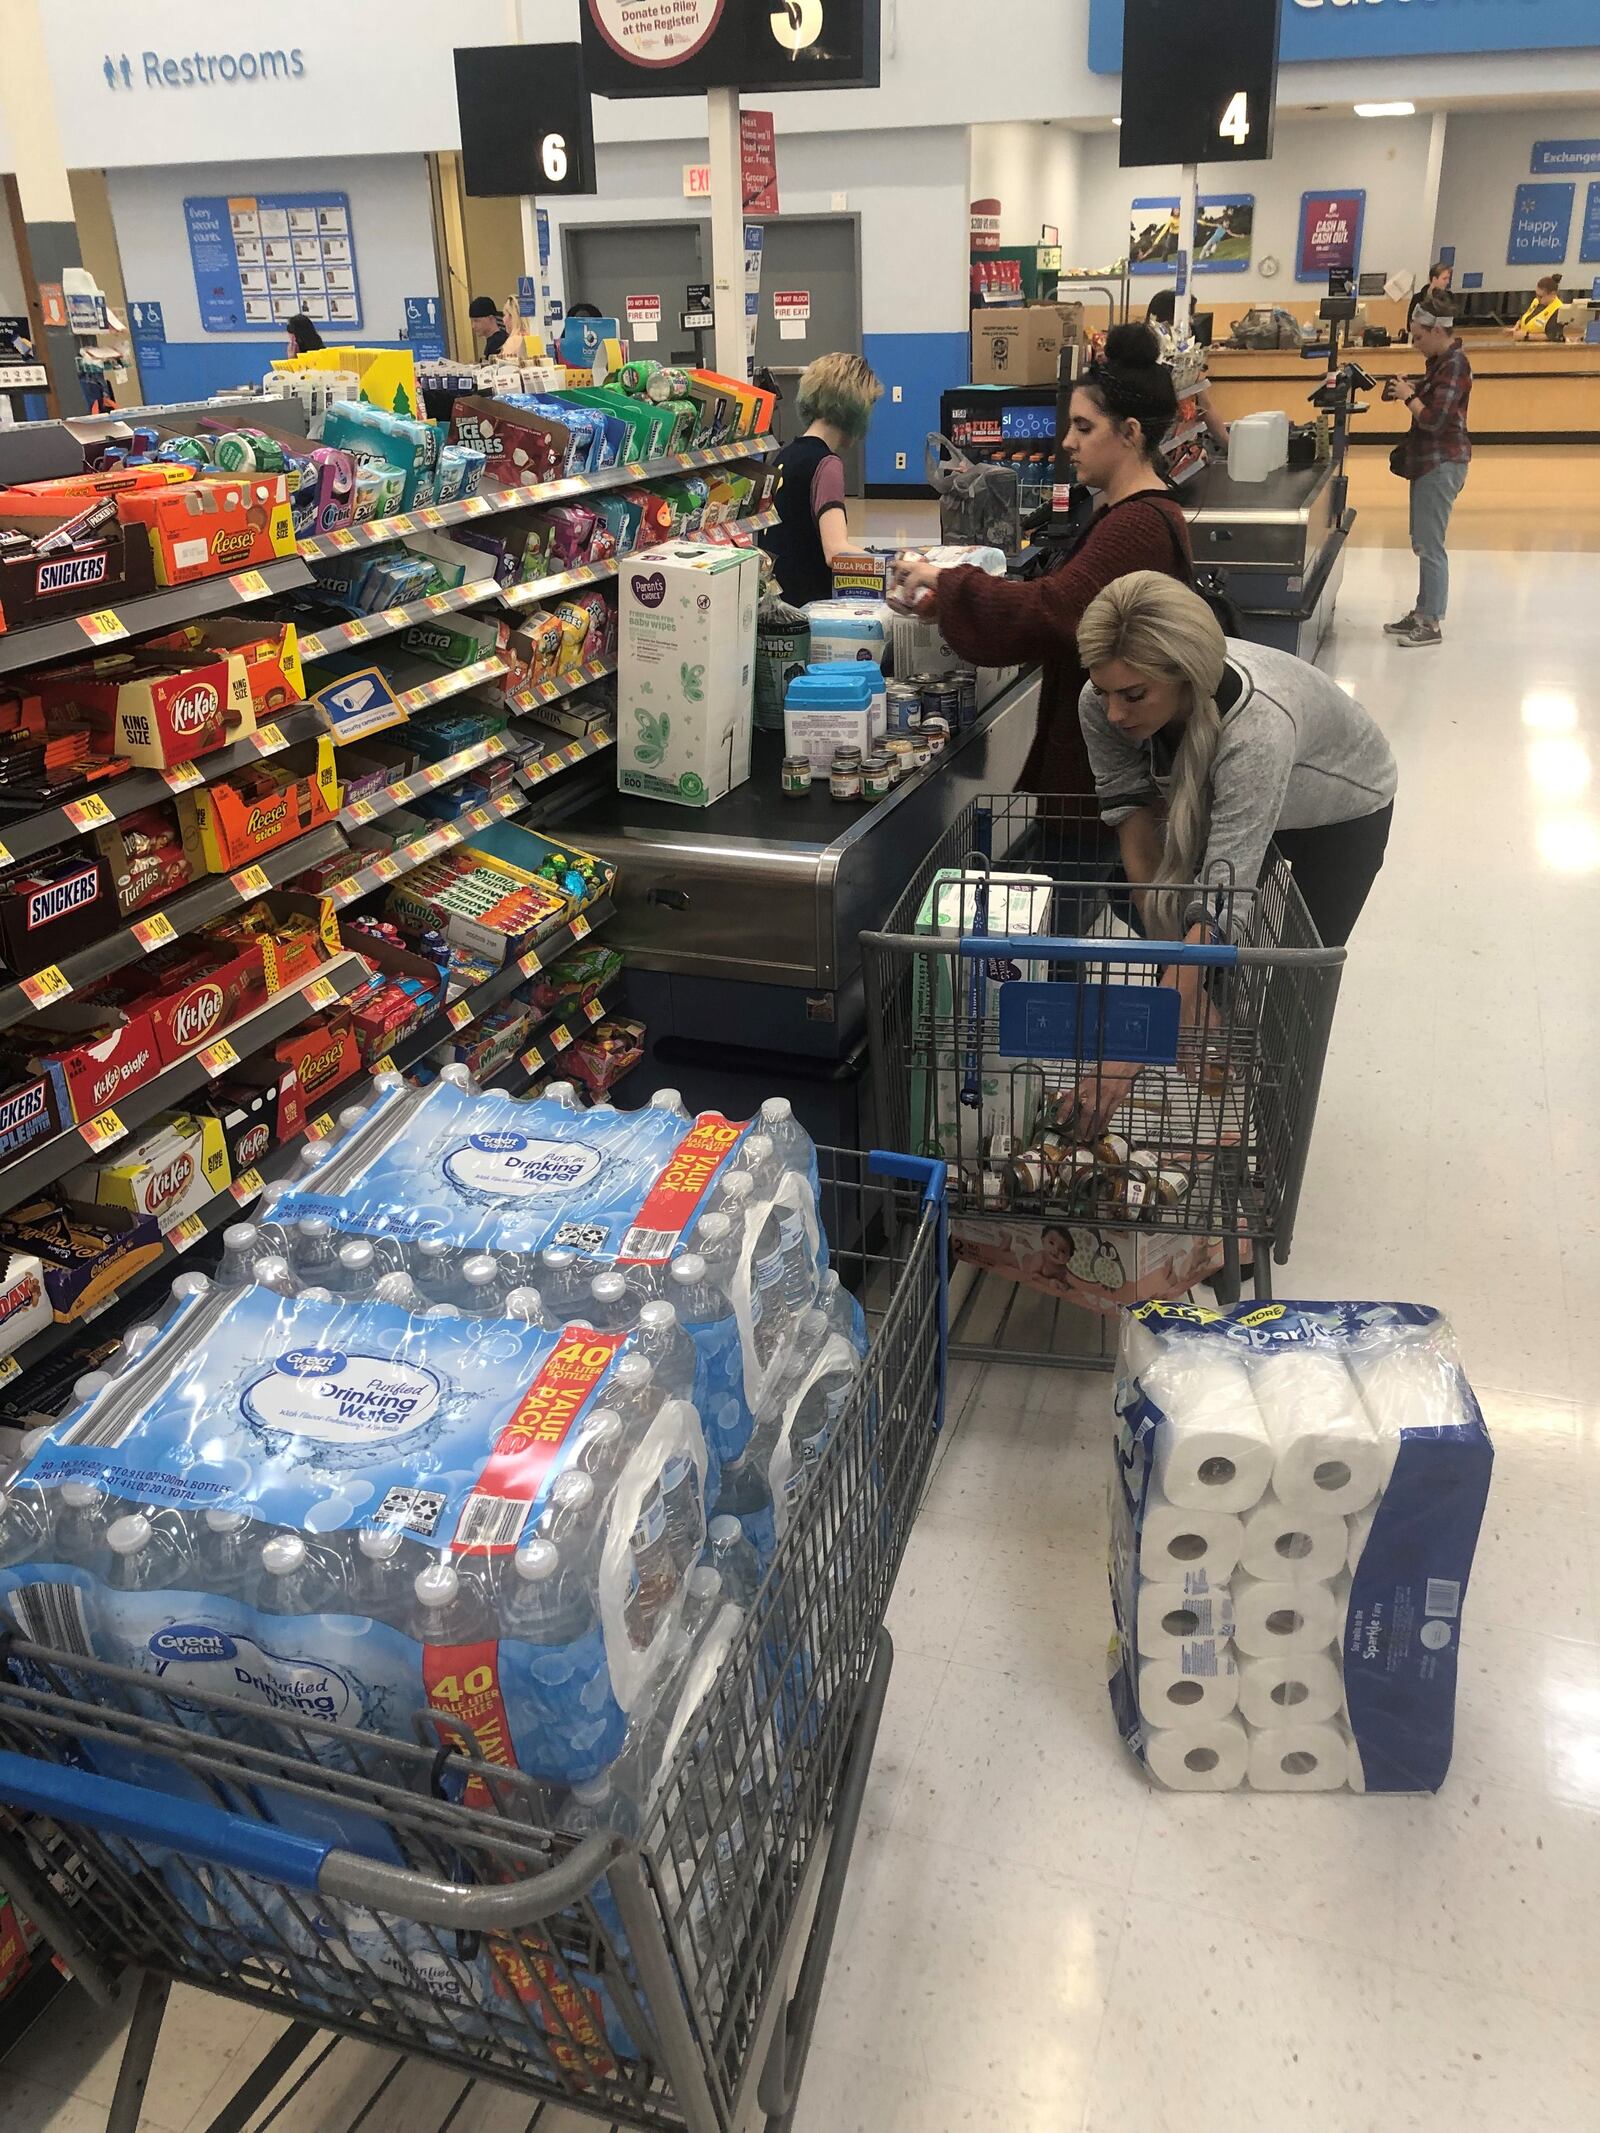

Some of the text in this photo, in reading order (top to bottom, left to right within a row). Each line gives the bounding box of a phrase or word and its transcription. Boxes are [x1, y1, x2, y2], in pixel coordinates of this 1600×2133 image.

[622, 1, 697, 22] Donate to Riley
[622, 13, 699, 35] at the Register!
[142, 48, 304, 86] Restrooms
[1219, 92, 1249, 145] 4
[541, 133, 567, 181] 6
[1316, 221, 1336, 233] CASH
[1518, 220, 1559, 233] Happy
[1311, 233, 1332, 245] CASH
[1516, 236, 1562, 248] to Help.
[792, 295, 808, 303] BLOCK
[645, 311, 659, 319] EXIT
[775, 308, 809, 316] FIRE EXIT
[458, 424, 480, 439] ICE
[277, 519, 289, 531] KING
[320, 503, 351, 532] Orbit
[211, 530, 255, 556] Reese's
[277, 530, 288, 540] SIZE
[40, 558, 104, 590] SNICKERS
[833, 562, 853, 571] MEGA
[855, 563, 874, 571] PACK
[636, 580, 663, 593] Parent's
[836, 576, 882, 589] NATURE VALLEY
[629, 618, 650, 630] Baby
[407, 628, 451, 647] Extra
[282, 654, 294, 664] KING
[283, 661, 295, 671] SIZE
[232, 678, 247, 692] KING
[234, 687, 249, 701] SIZE
[121, 714, 149, 730] KING
[340, 723, 360, 736] Security
[127, 729, 151, 745] SIZE
[320, 765, 333, 778] KING
[320, 774, 333, 787] SIZE
[624, 777, 642, 789] 800
[247, 800, 288, 835] Reese's
[247, 869, 265, 888] 1.00
[475, 868, 521, 892] Mamba
[119, 868, 159, 906] Turtles
[31, 873, 96, 923] SNICKERS
[394, 899, 441, 930] Mamba
[150, 916, 170, 933] 1.00
[40, 973, 63, 992] 1.34
[212, 1046, 234, 1062] 1.34
[298, 1040, 344, 1084] Reese's
[70, 1057, 82, 1068] 16
[284, 1100, 297, 1115] KING
[285, 1110, 297, 1123] SIZE
[478, 1134, 518, 1146] Great
[692, 1124, 739, 1142] 40
[207, 1149, 223, 1166] KING
[505, 1156, 584, 1174] Drinking
[208, 1158, 223, 1174] SIZE
[660, 1154, 697, 1191] PACK
[680, 1156, 719, 1192] VALUE
[243, 1171, 260, 1187] 1.34
[523, 1169, 578, 1182] Water
[388, 1226, 412, 1235] TOTAL
[1246, 1307, 1282, 1325] MORE
[286, 1352, 337, 1367] Great
[552, 1342, 612, 1367] 40
[293, 1363, 330, 1373] Value
[545, 1360, 604, 1375] HALF LITER
[546, 1370, 593, 1381] BOTTLES
[366, 1378, 429, 1396] Purified
[319, 1382, 418, 1413] Drinking
[338, 1402, 410, 1424] Water
[507, 1385, 559, 1438] PACK
[534, 1387, 586, 1442] VALUE
[158, 1474, 188, 1487] 500mL
[191, 1479, 231, 1494] BOTTLES
[167, 1488, 196, 1500] TOTAL
[157, 1635, 222, 1649] Great
[1362, 1620, 1382, 1659] Sparkle
[177, 1642, 224, 1655] Value
[431, 1665, 493, 1702] 40
[468, 1689, 499, 1707] LITER
